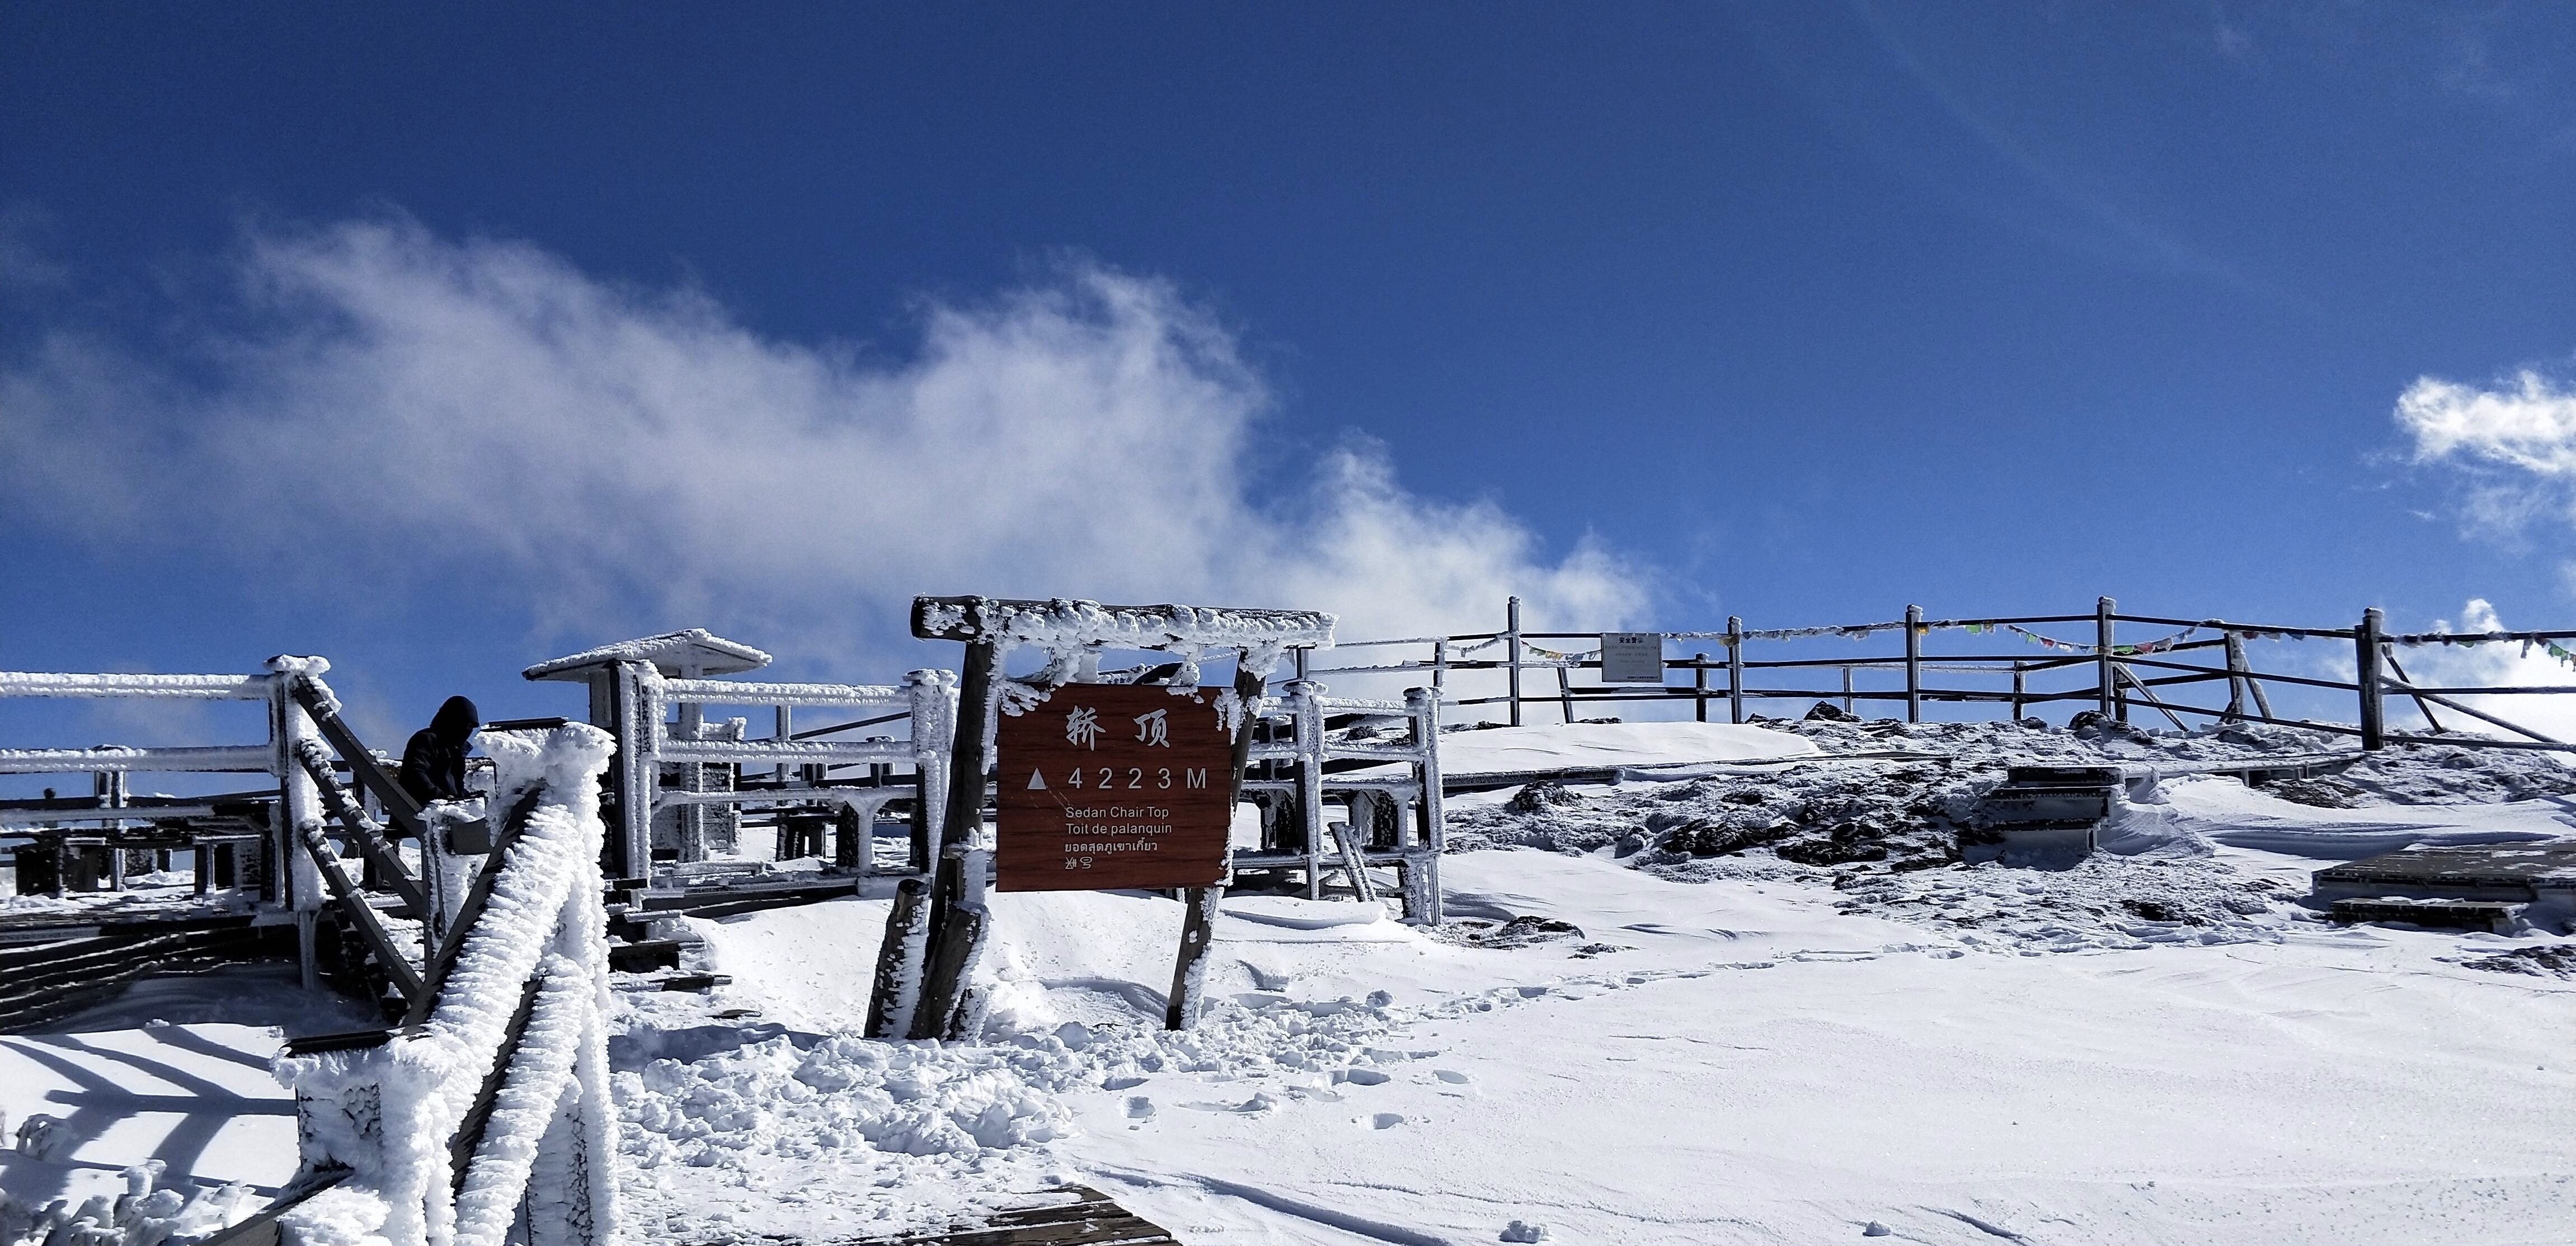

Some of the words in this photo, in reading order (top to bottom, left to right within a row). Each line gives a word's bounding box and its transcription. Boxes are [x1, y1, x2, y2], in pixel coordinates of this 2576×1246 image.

[1066, 706, 1169, 751] 轿顶
[1066, 806, 1106, 818] Sedan
[1110, 806, 1144, 817] Chair
[1147, 806, 1169, 820] Top
[1066, 824, 1089, 834] Toit
[1092, 824, 1107, 834] de
[1112, 823, 1172, 836] palanquin
